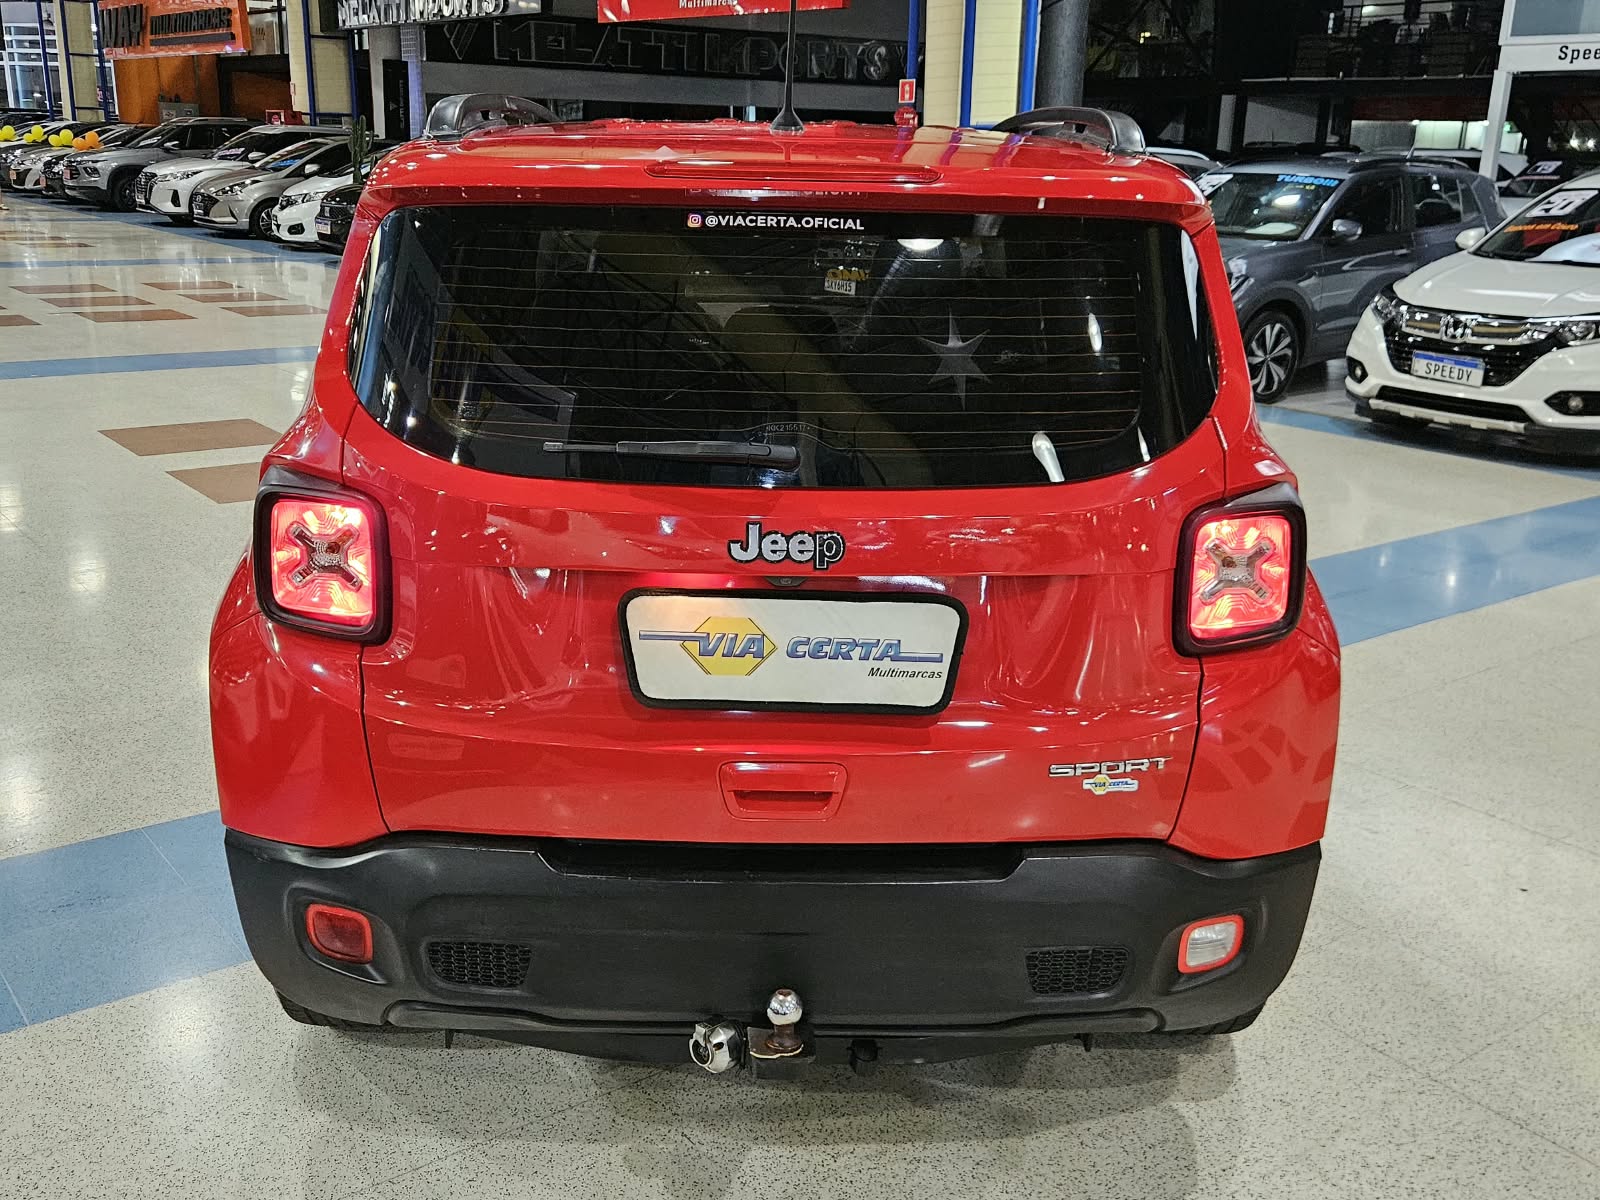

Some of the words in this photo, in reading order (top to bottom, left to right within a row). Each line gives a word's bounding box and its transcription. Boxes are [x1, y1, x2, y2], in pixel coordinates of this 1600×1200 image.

[99, 4, 144, 48] WAY
[150, 7, 233, 35] MULTIMARCAS
[705, 215, 865, 230] @VIACERTA.OFICIAL
[1425, 362, 1472, 382] SPEEDY
[729, 522, 843, 569] Jeep
[699, 632, 765, 658] VIA
[786, 636, 901, 661] CERTA
[867, 667, 943, 679] Multimarcas
[1048, 756, 1173, 777] SPORT
